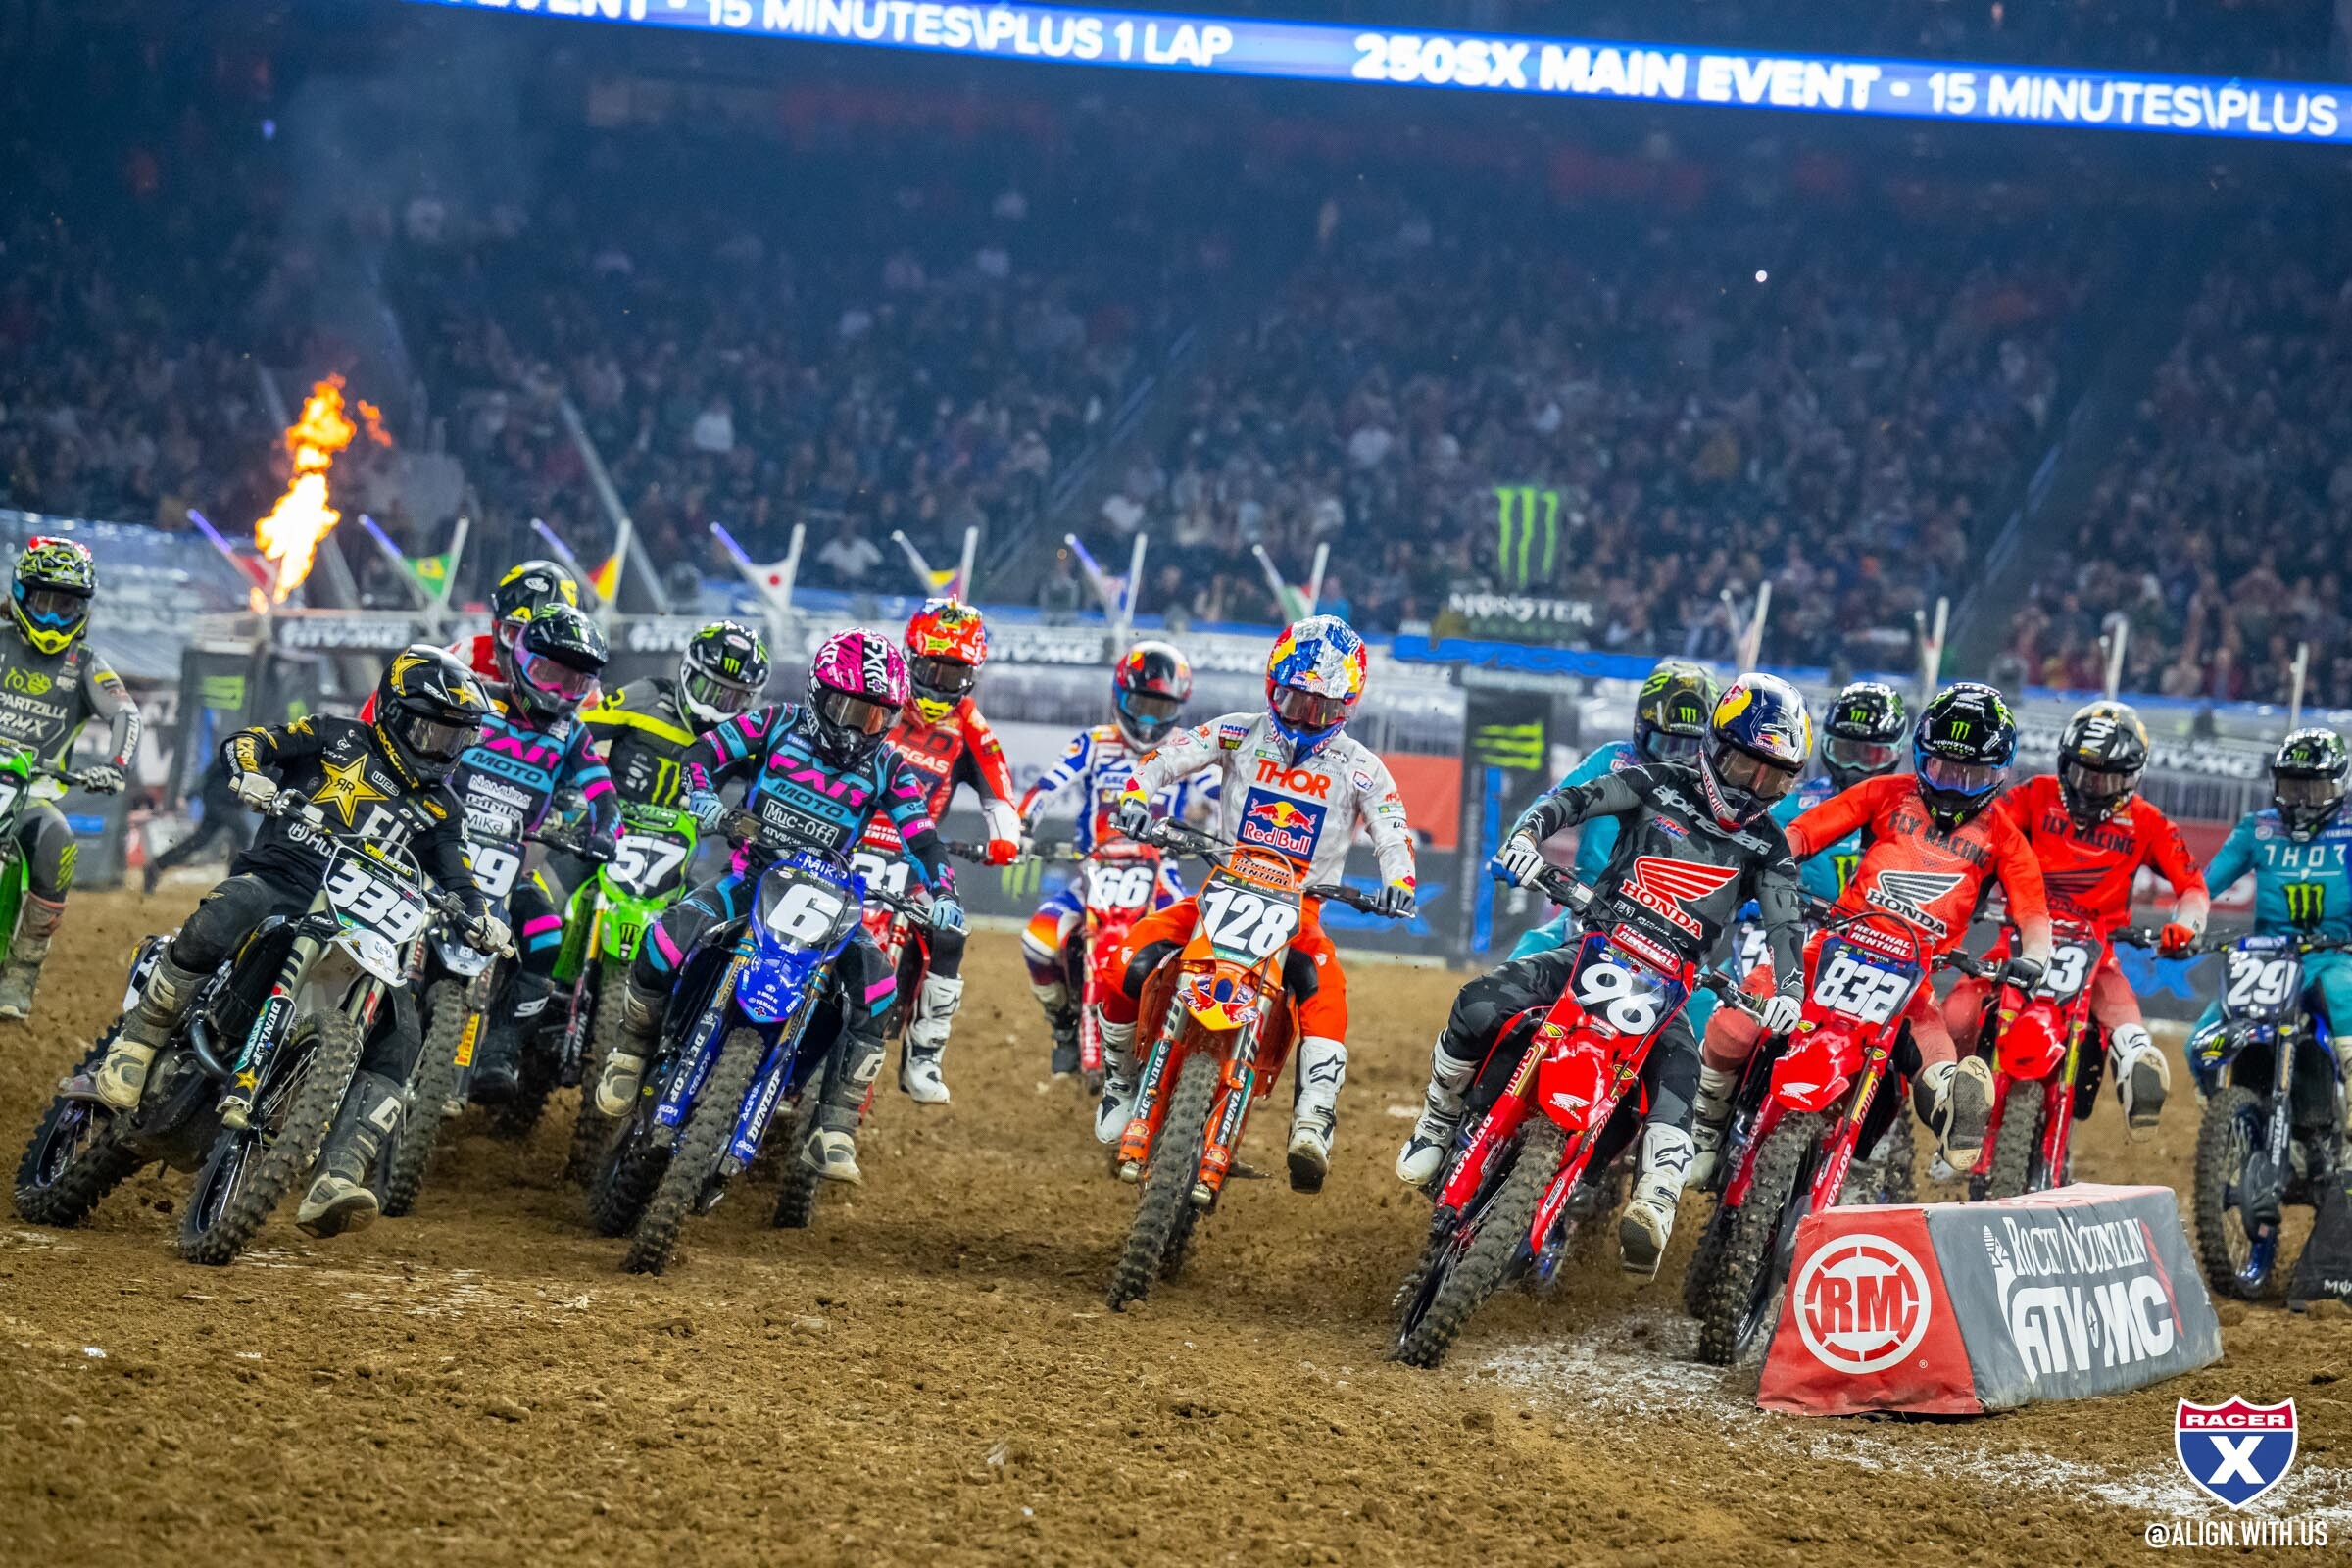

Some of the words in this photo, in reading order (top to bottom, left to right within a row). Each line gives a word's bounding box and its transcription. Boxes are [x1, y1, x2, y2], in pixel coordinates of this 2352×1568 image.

[707, 0, 753, 27] 15
[1113, 22, 1134, 61] 1
[1143, 24, 1233, 67] LAP
[1352, 33, 1529, 90] 250SX
[1539, 45, 1687, 99] MAIN
[1697, 55, 1881, 110] EVENT
[1928, 73, 1977, 115] 15
[472, 751, 543, 783] MOTO
[1932, 739, 1976, 754] MONSTER
[469, 775, 532, 809] NAMURA
[774, 784, 844, 819] MOTO
[1256, 759, 1331, 800] THOR
[767, 804, 835, 844] Muc-Off
[1244, 821, 1276, 845] Red
[1276, 828, 1312, 856] Bull
[1887, 811, 1923, 836] FLY
[607, 835, 687, 888] 57
[1233, 864, 1290, 887] RENTHAL
[328, 860, 425, 945] 339
[1088, 866, 1154, 910] 66
[1620, 879, 1704, 940] HONDA
[767, 884, 843, 943] 6
[1204, 887, 1298, 958] 128
[1853, 924, 1911, 949] RENTHAL
[1867, 891, 1946, 936] HONDA
[1623, 925, 1678, 959] RENTHAL
[1850, 932, 1909, 957] RENTHAL
[1573, 962, 1664, 1035] 96
[1813, 957, 1910, 1026] 832
[2228, 958, 2297, 1006] 29
[748, 1069, 781, 1142] DUNLOP
[1222, 1068, 1247, 1133] DUNLP
[1779, 1090, 1812, 1106] HONDA
[1448, 1113, 1494, 1187] DUNLOP
[2002, 1216, 2066, 1276] ROCKY
[1820, 1275, 1902, 1333] RM
